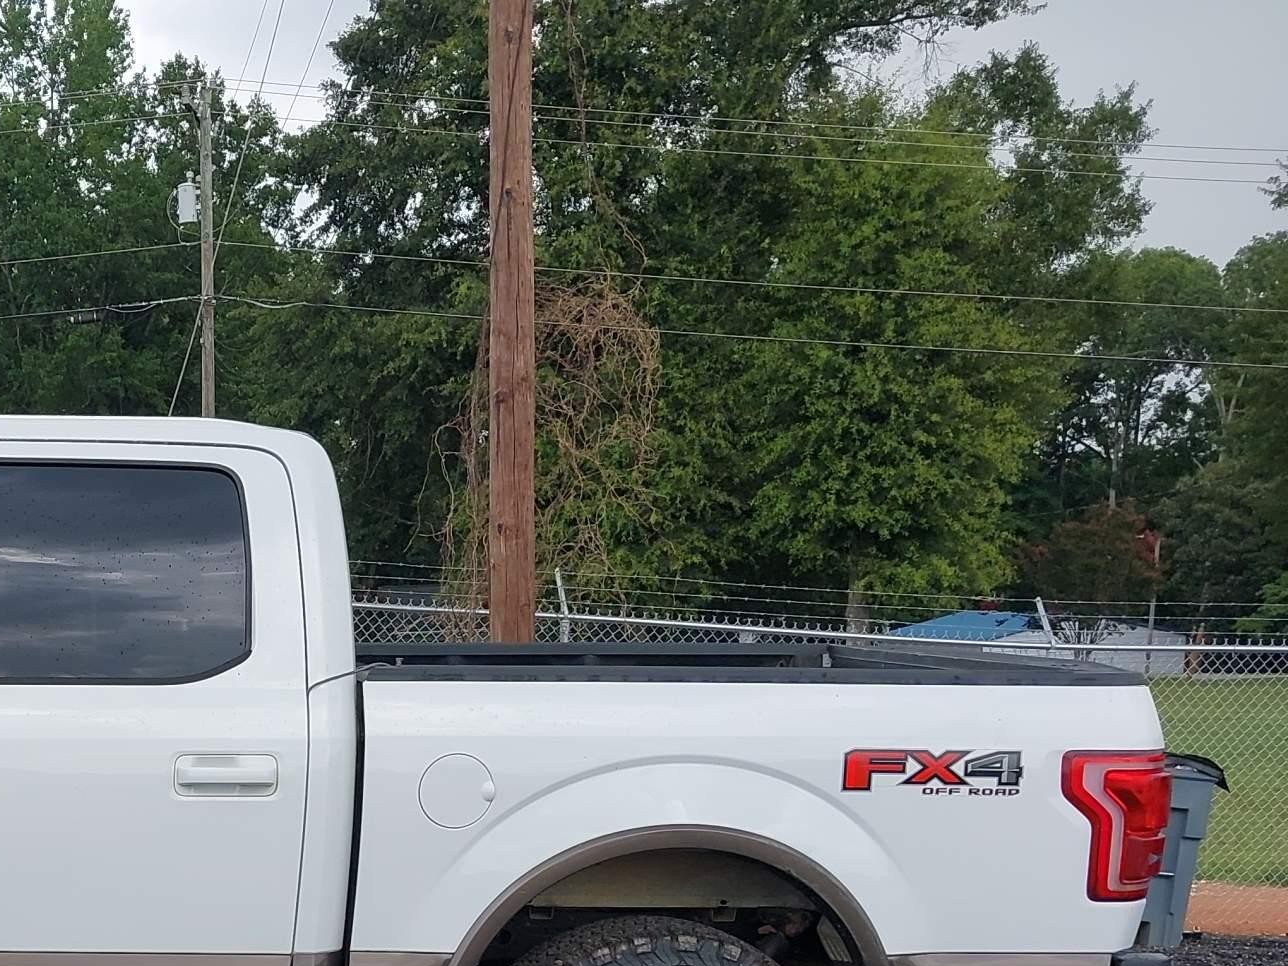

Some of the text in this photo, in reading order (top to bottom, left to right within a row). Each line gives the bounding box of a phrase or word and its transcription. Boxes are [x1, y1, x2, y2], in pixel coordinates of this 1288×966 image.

[841, 749, 1024, 791] FX4
[921, 787, 1021, 796] OFF ROAD
